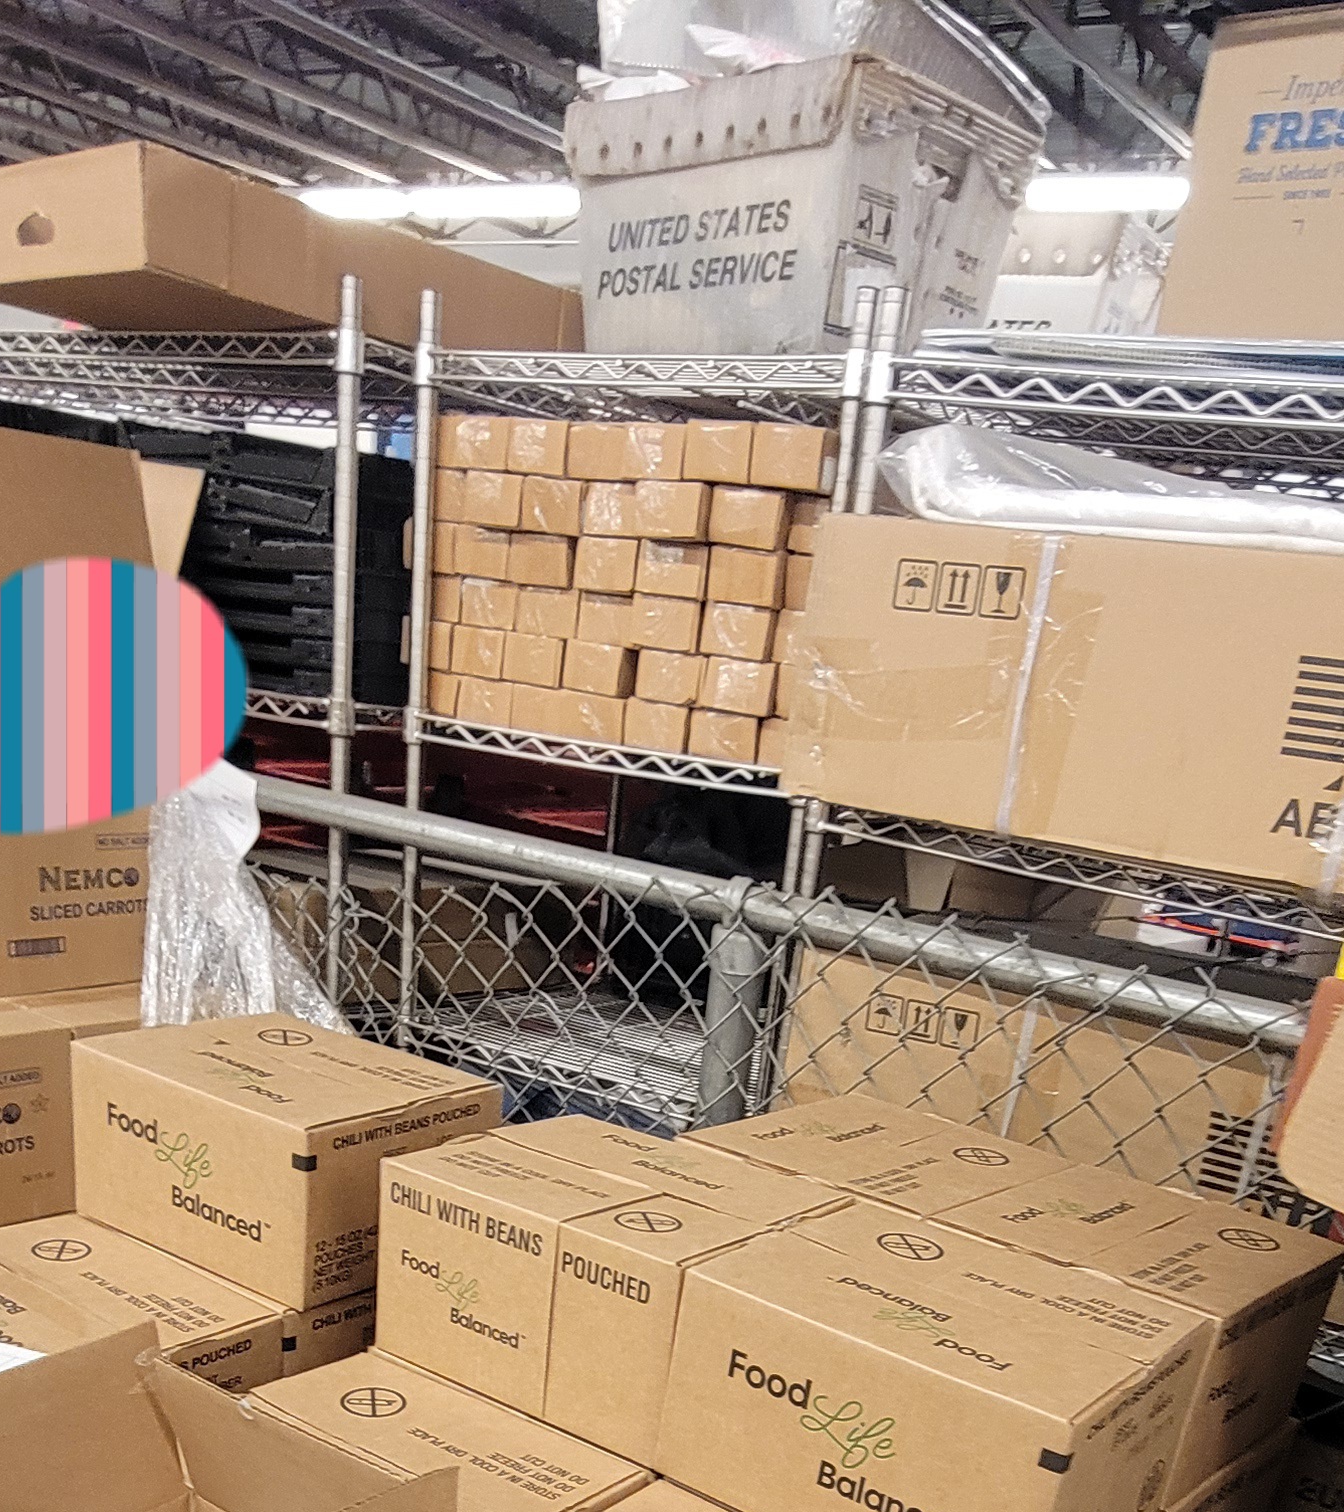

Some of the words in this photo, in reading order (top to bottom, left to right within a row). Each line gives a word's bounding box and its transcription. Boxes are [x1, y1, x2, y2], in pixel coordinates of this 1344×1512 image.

[1275, 163, 1328, 181] Selected
[608, 212, 690, 253] UNITED
[694, 199, 792, 243] STATES
[597, 261, 682, 299] POSTAL
[689, 249, 798, 291] SERVICE
[39, 866, 140, 893] NEMCO
[29, 902, 83, 921] SLICED
[107, 1102, 159, 1145] Food
[333, 1134, 364, 1151] CHILI
[364, 1127, 394, 1144] WITH
[395, 1116, 431, 1135] BEANS
[432, 1103, 482, 1126] POUCHED
[156, 1131, 214, 1190] Life
[601, 1132, 659, 1153] Food
[630, 1157, 727, 1192] Balanced
[171, 1184, 264, 1244] Balanced
[1000, 1205, 1046, 1224] Food
[390, 1181, 432, 1217] CHILI
[436, 1197, 481, 1234] WITH
[485, 1216, 544, 1257] BEANS
[560, 1251, 652, 1305] POUCHED
[400, 1249, 441, 1280] Food
[435, 1268, 480, 1312] Life
[961, 1271, 1006, 1291] PLACE
[835, 1274, 953, 1324] Balanced
[312, 1311, 342, 1331] CHILI
[450, 1306, 520, 1350] Balanced
[191, 1337, 254, 1372] POUCHED
[933, 1337, 1015, 1373] Food
[727, 1347, 813, 1410] Food
[799, 1394, 897, 1470] Life
[406, 1426, 447, 1448] PLACE
[443, 1444, 470, 1458] DRY
[485, 1451, 534, 1475] FREEZE
[519, 1453, 547, 1467] CUT
[468, 1455, 500, 1474] COOL
[528, 1469, 557, 1485] NOT
[545, 1464, 574, 1479] NOT
[508, 1474, 524, 1485] IN
[519, 1479, 563, 1501] STORE
[552, 1482, 577, 1493] DO
[568, 1474, 591, 1486] DO
